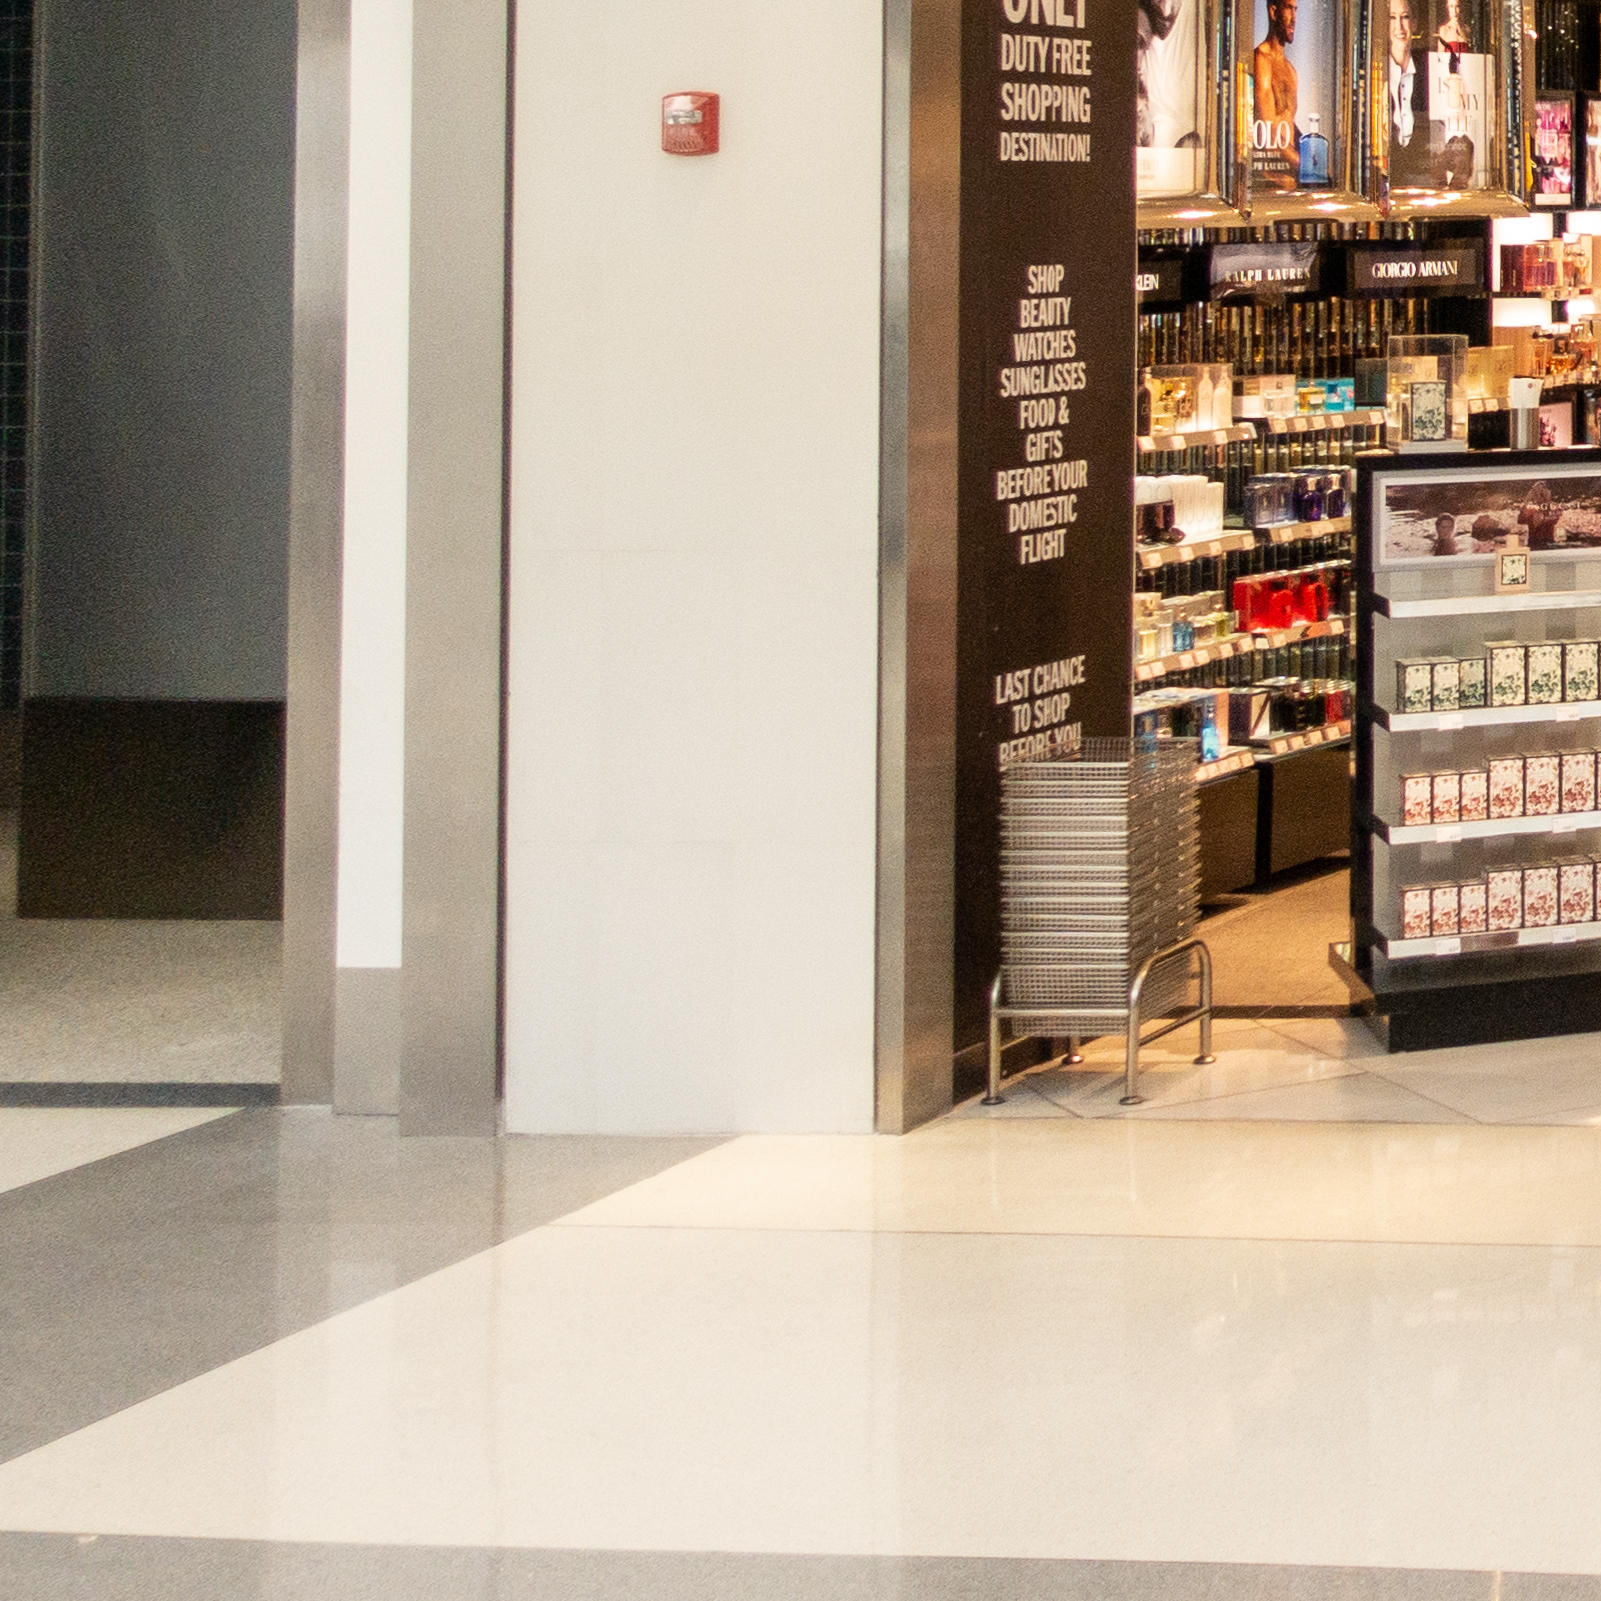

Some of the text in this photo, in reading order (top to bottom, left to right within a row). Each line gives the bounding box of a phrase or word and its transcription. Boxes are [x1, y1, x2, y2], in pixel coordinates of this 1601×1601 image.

[1000, 33, 1092, 76] DUTY FREE
[1000, 81, 1091, 124] SHOPPING
[1000, 131, 1091, 163] DESTINATION!
[1028, 265, 1065, 294] SHOP
[1225, 266, 1311, 284] RALPH LAUREN
[1372, 259, 1459, 279] GIORGIO ARMANI
[1019, 296, 1071, 329] BEAUTY
[1013, 329, 1077, 365] WATCHES
[1001, 361, 1087, 398] SUNGLASSES
[1019, 396, 1070, 430] FOOD &
[1026, 430, 1064, 462] GIFTS
[997, 459, 1088, 503] BEFORE YOUR
[1008, 494, 1079, 534] DOMESTIC
[1019, 528, 1068, 566] FLIGHT
[996, 654, 1086, 704] LAST CHANCE
[1012, 692, 1071, 734] TO SHOP
